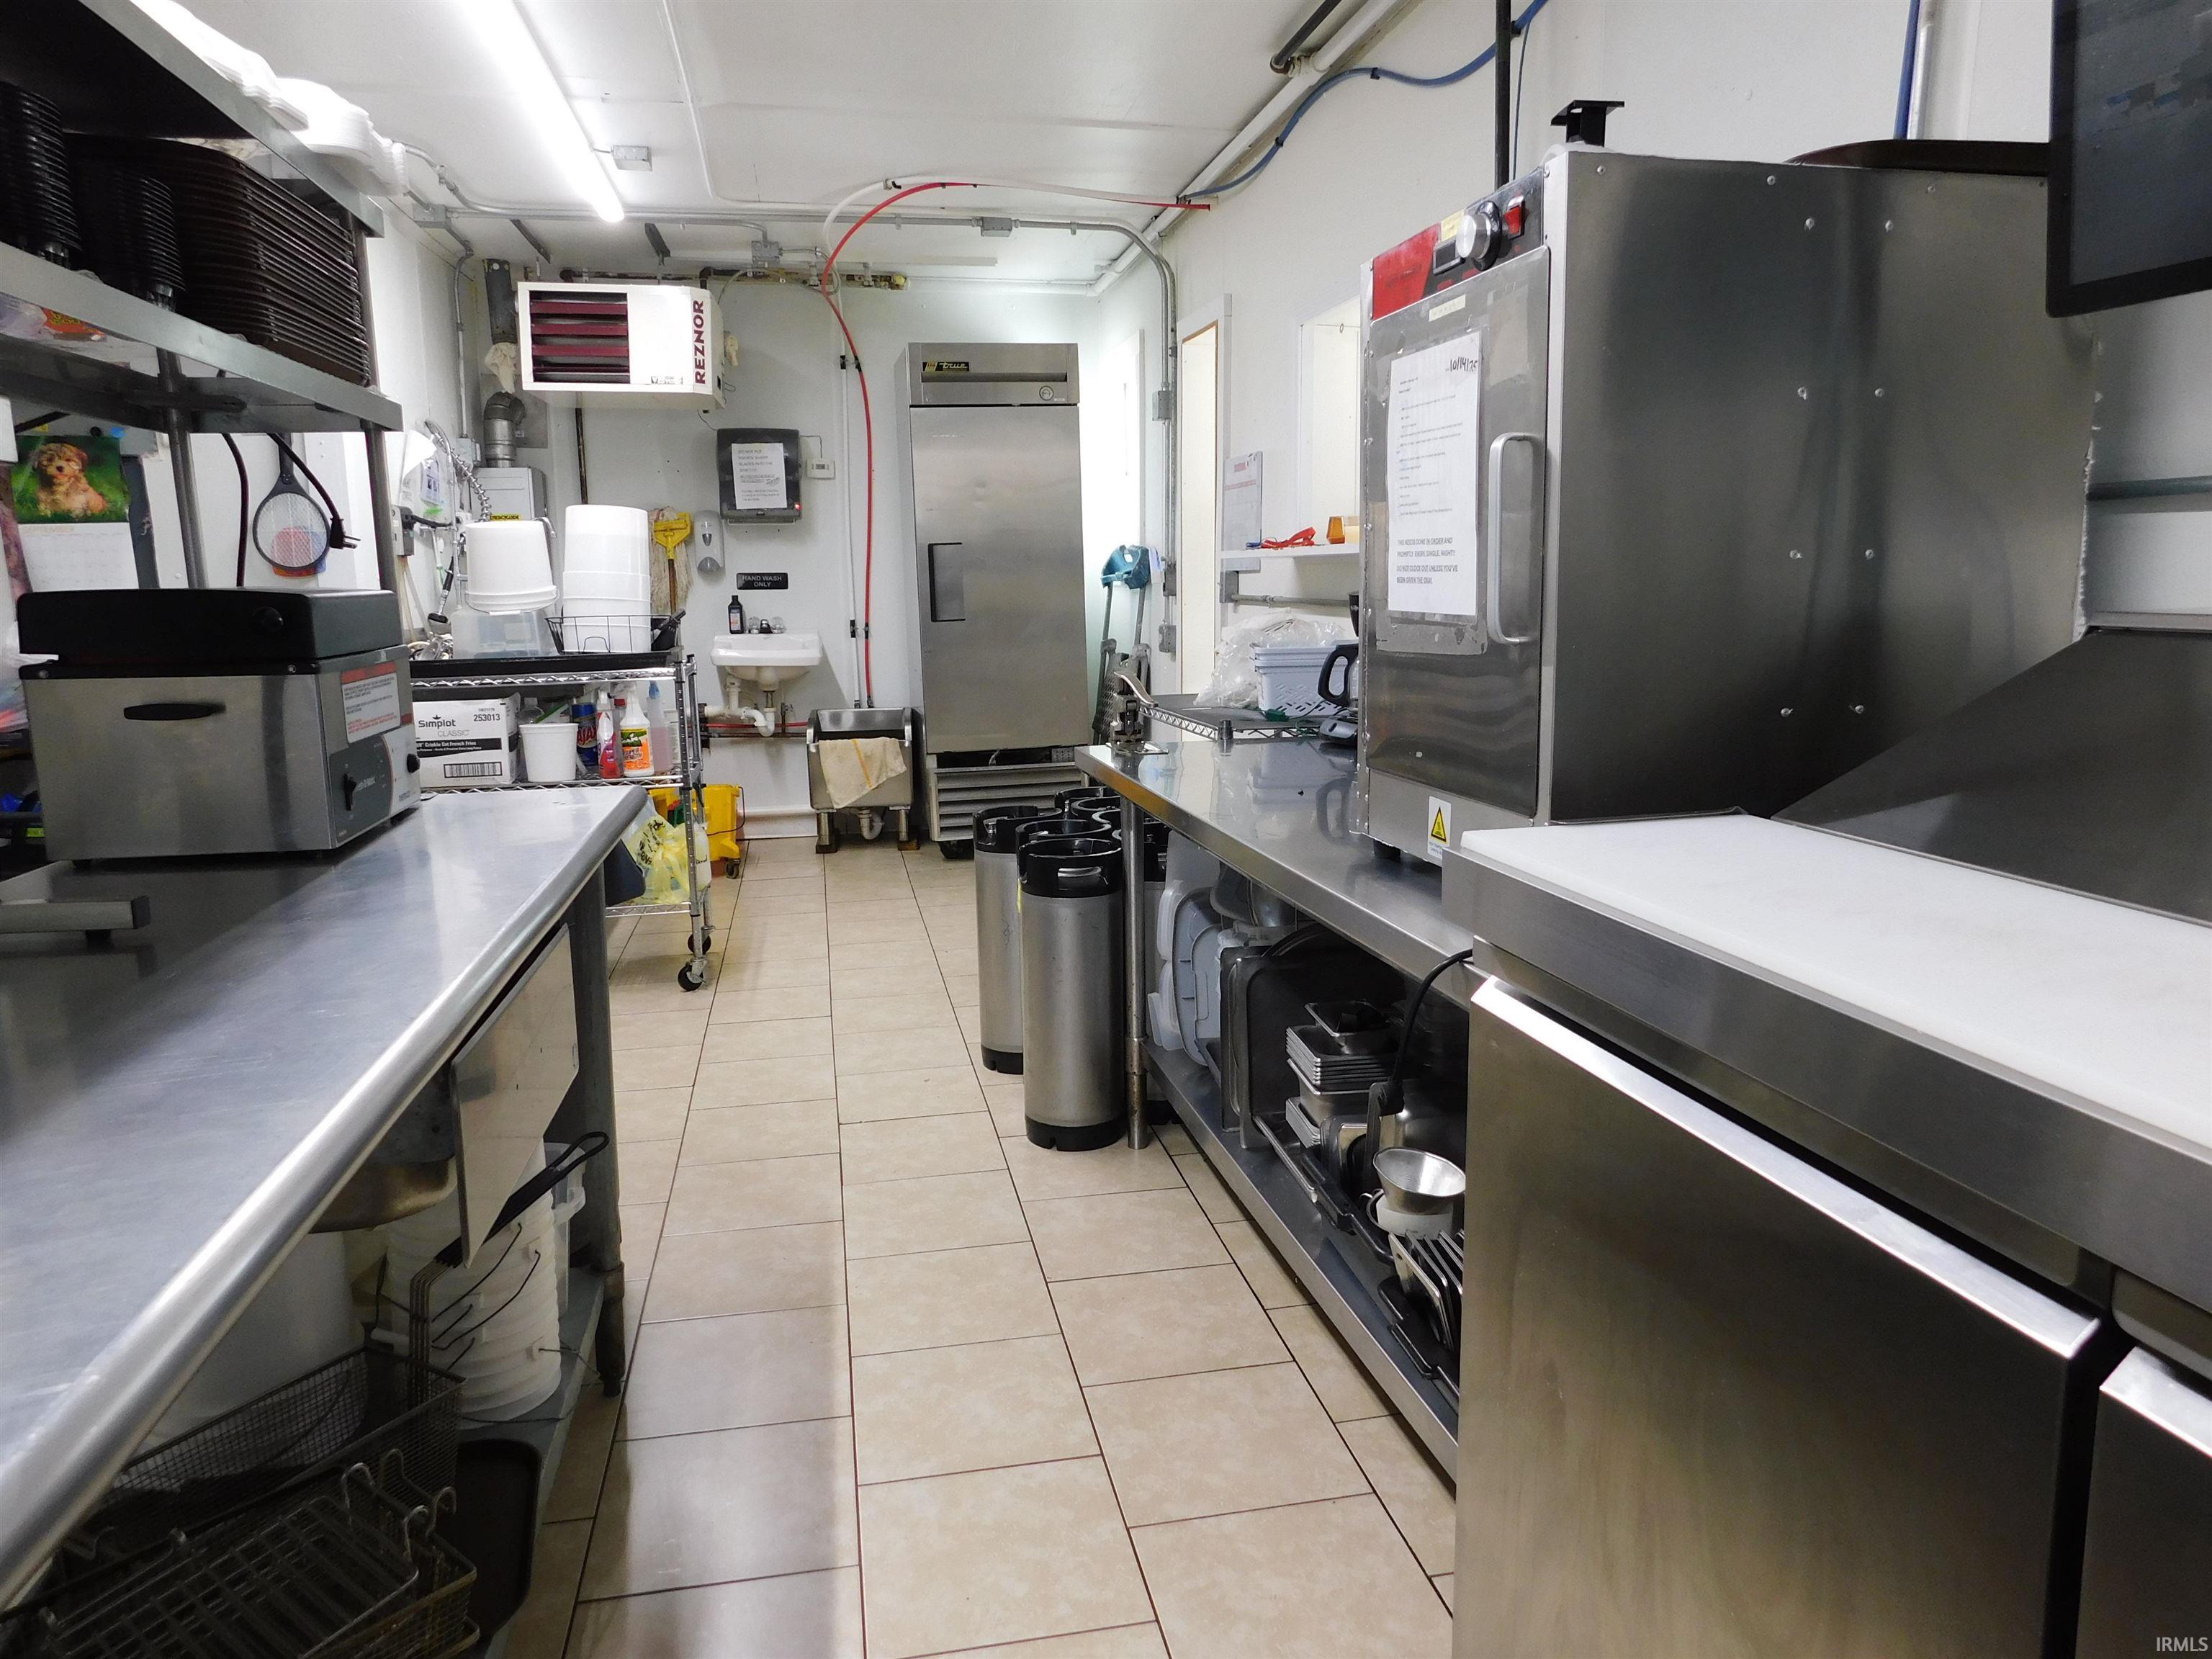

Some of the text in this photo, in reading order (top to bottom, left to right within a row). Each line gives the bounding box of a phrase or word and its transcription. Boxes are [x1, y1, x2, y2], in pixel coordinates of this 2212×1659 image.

[693, 300, 706, 385] REZNOR
[473, 713, 500, 721] 253013
[418, 719, 457, 729] Simplot
